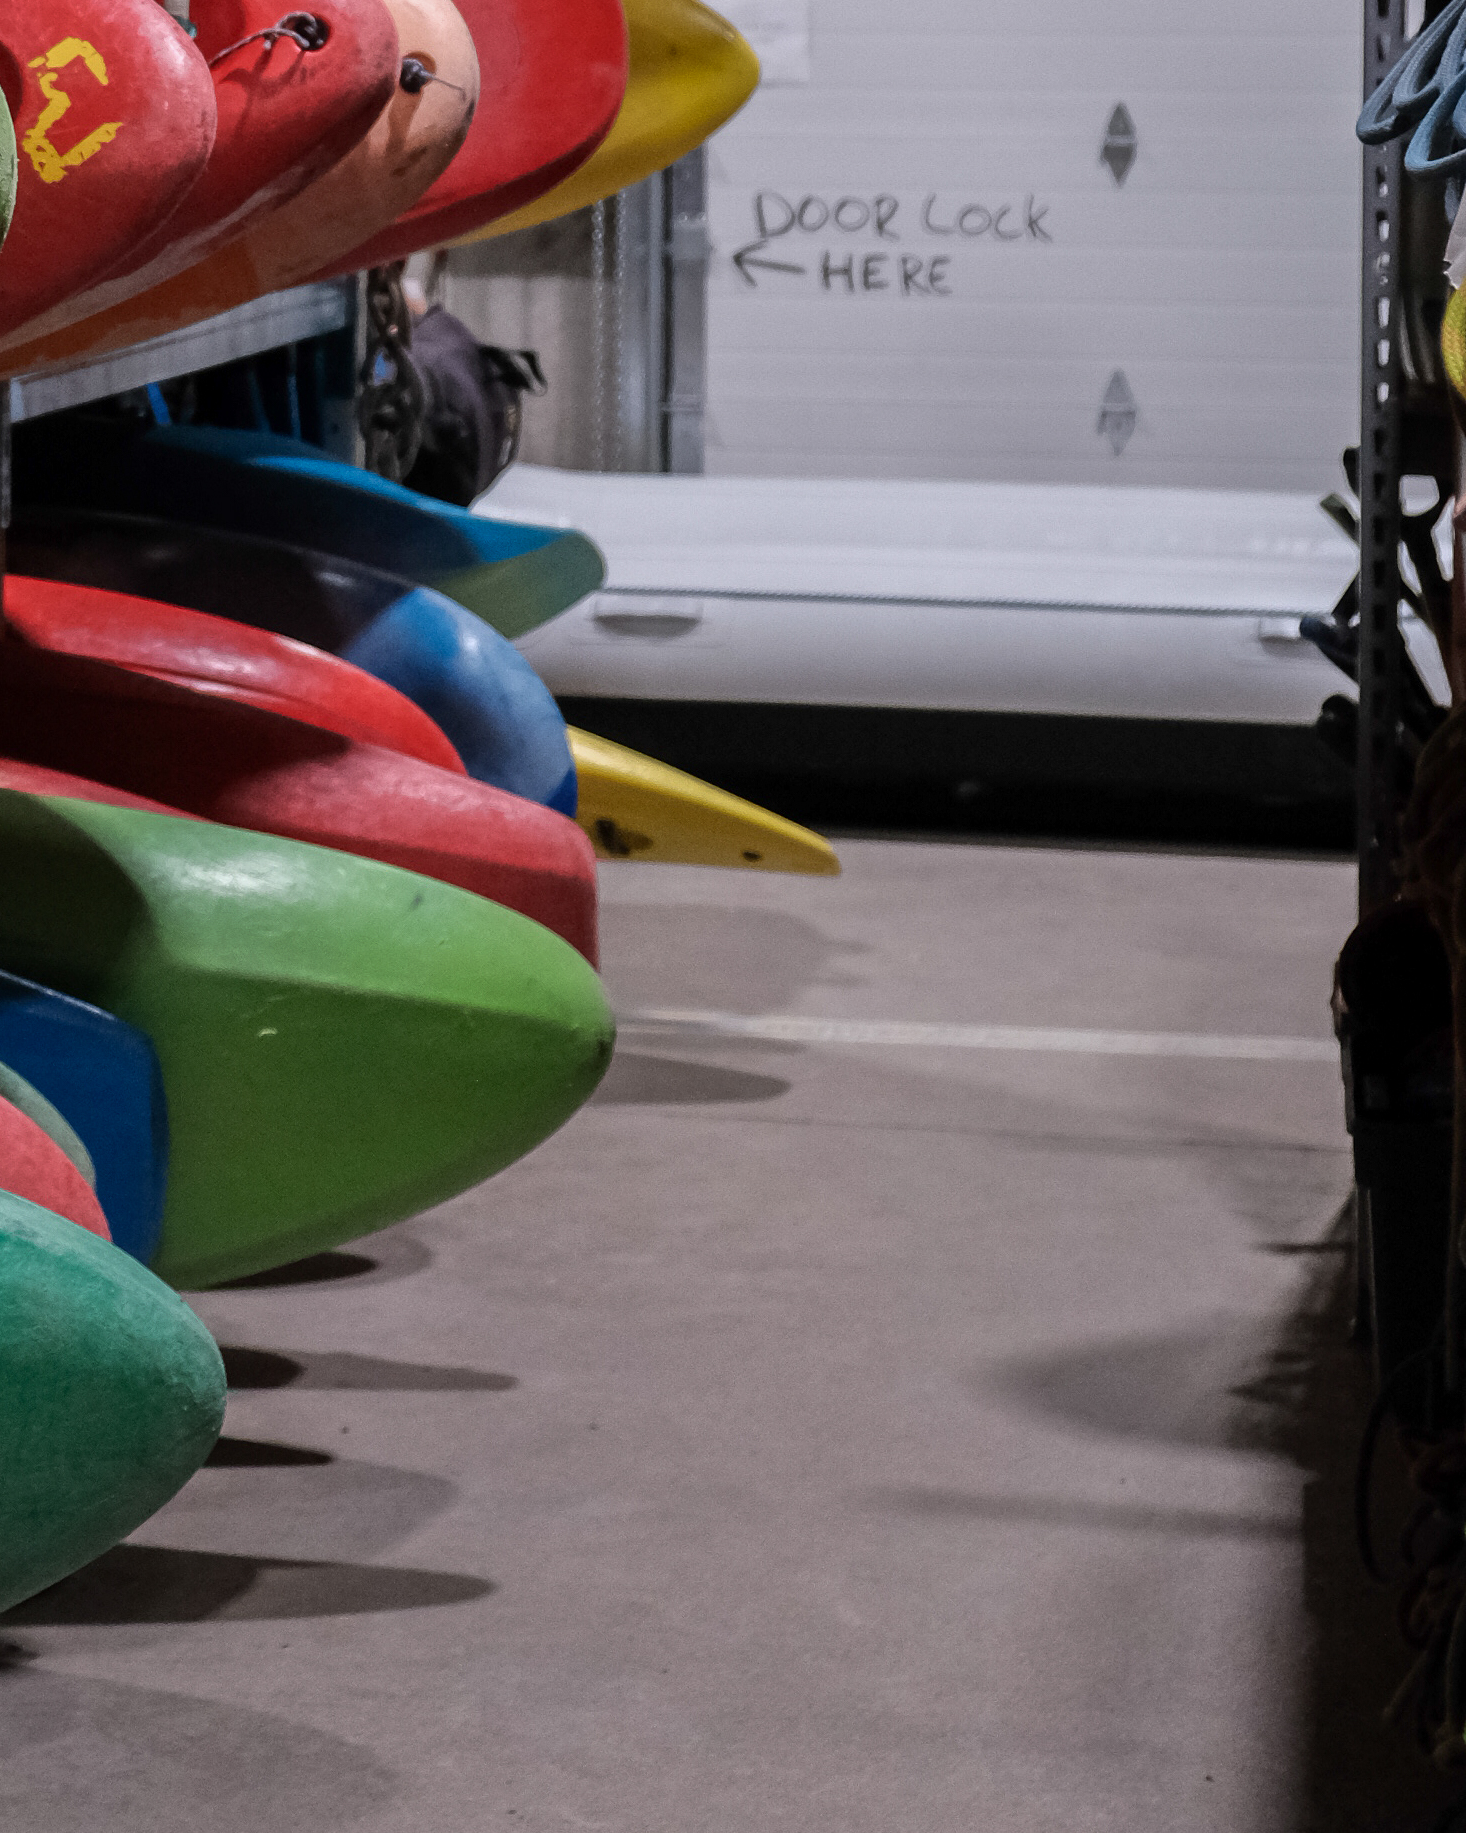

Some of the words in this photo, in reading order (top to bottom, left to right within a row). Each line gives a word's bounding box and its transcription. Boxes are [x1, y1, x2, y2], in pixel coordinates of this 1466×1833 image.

[754, 190, 901, 241] DOOR
[922, 194, 1053, 243] LOCK
[819, 249, 953, 297] HERE
